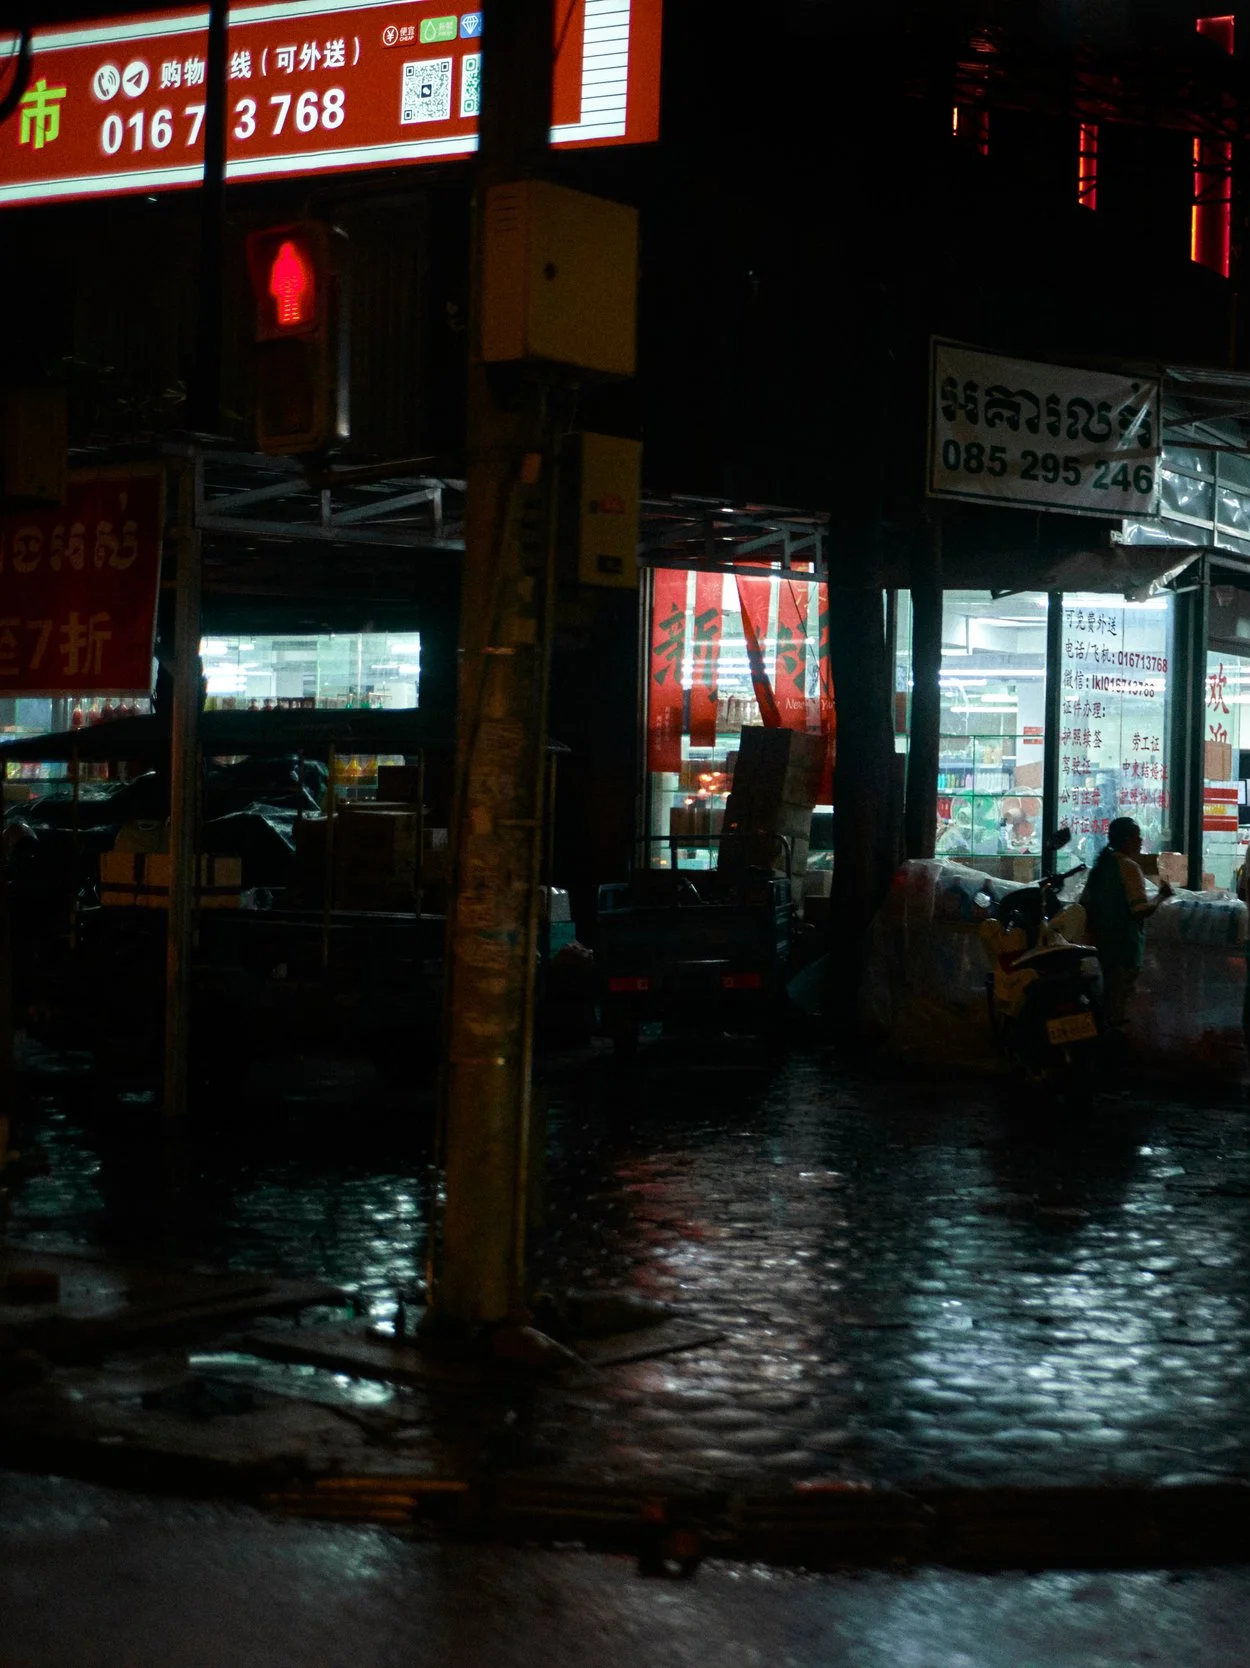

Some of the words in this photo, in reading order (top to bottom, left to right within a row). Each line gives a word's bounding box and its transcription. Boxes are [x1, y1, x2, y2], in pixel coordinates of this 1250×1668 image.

[160, 37, 361, 89] 购物线（可外送）
[18, 79, 67, 149] 市
[102, 108, 173, 155] 016
[185, 98, 257, 146] 73
[270, 88, 346, 136] 768
[943, 439, 1007, 477] 085
[1020, 450, 1081, 486] 295
[1093, 460, 1153, 494] 246
